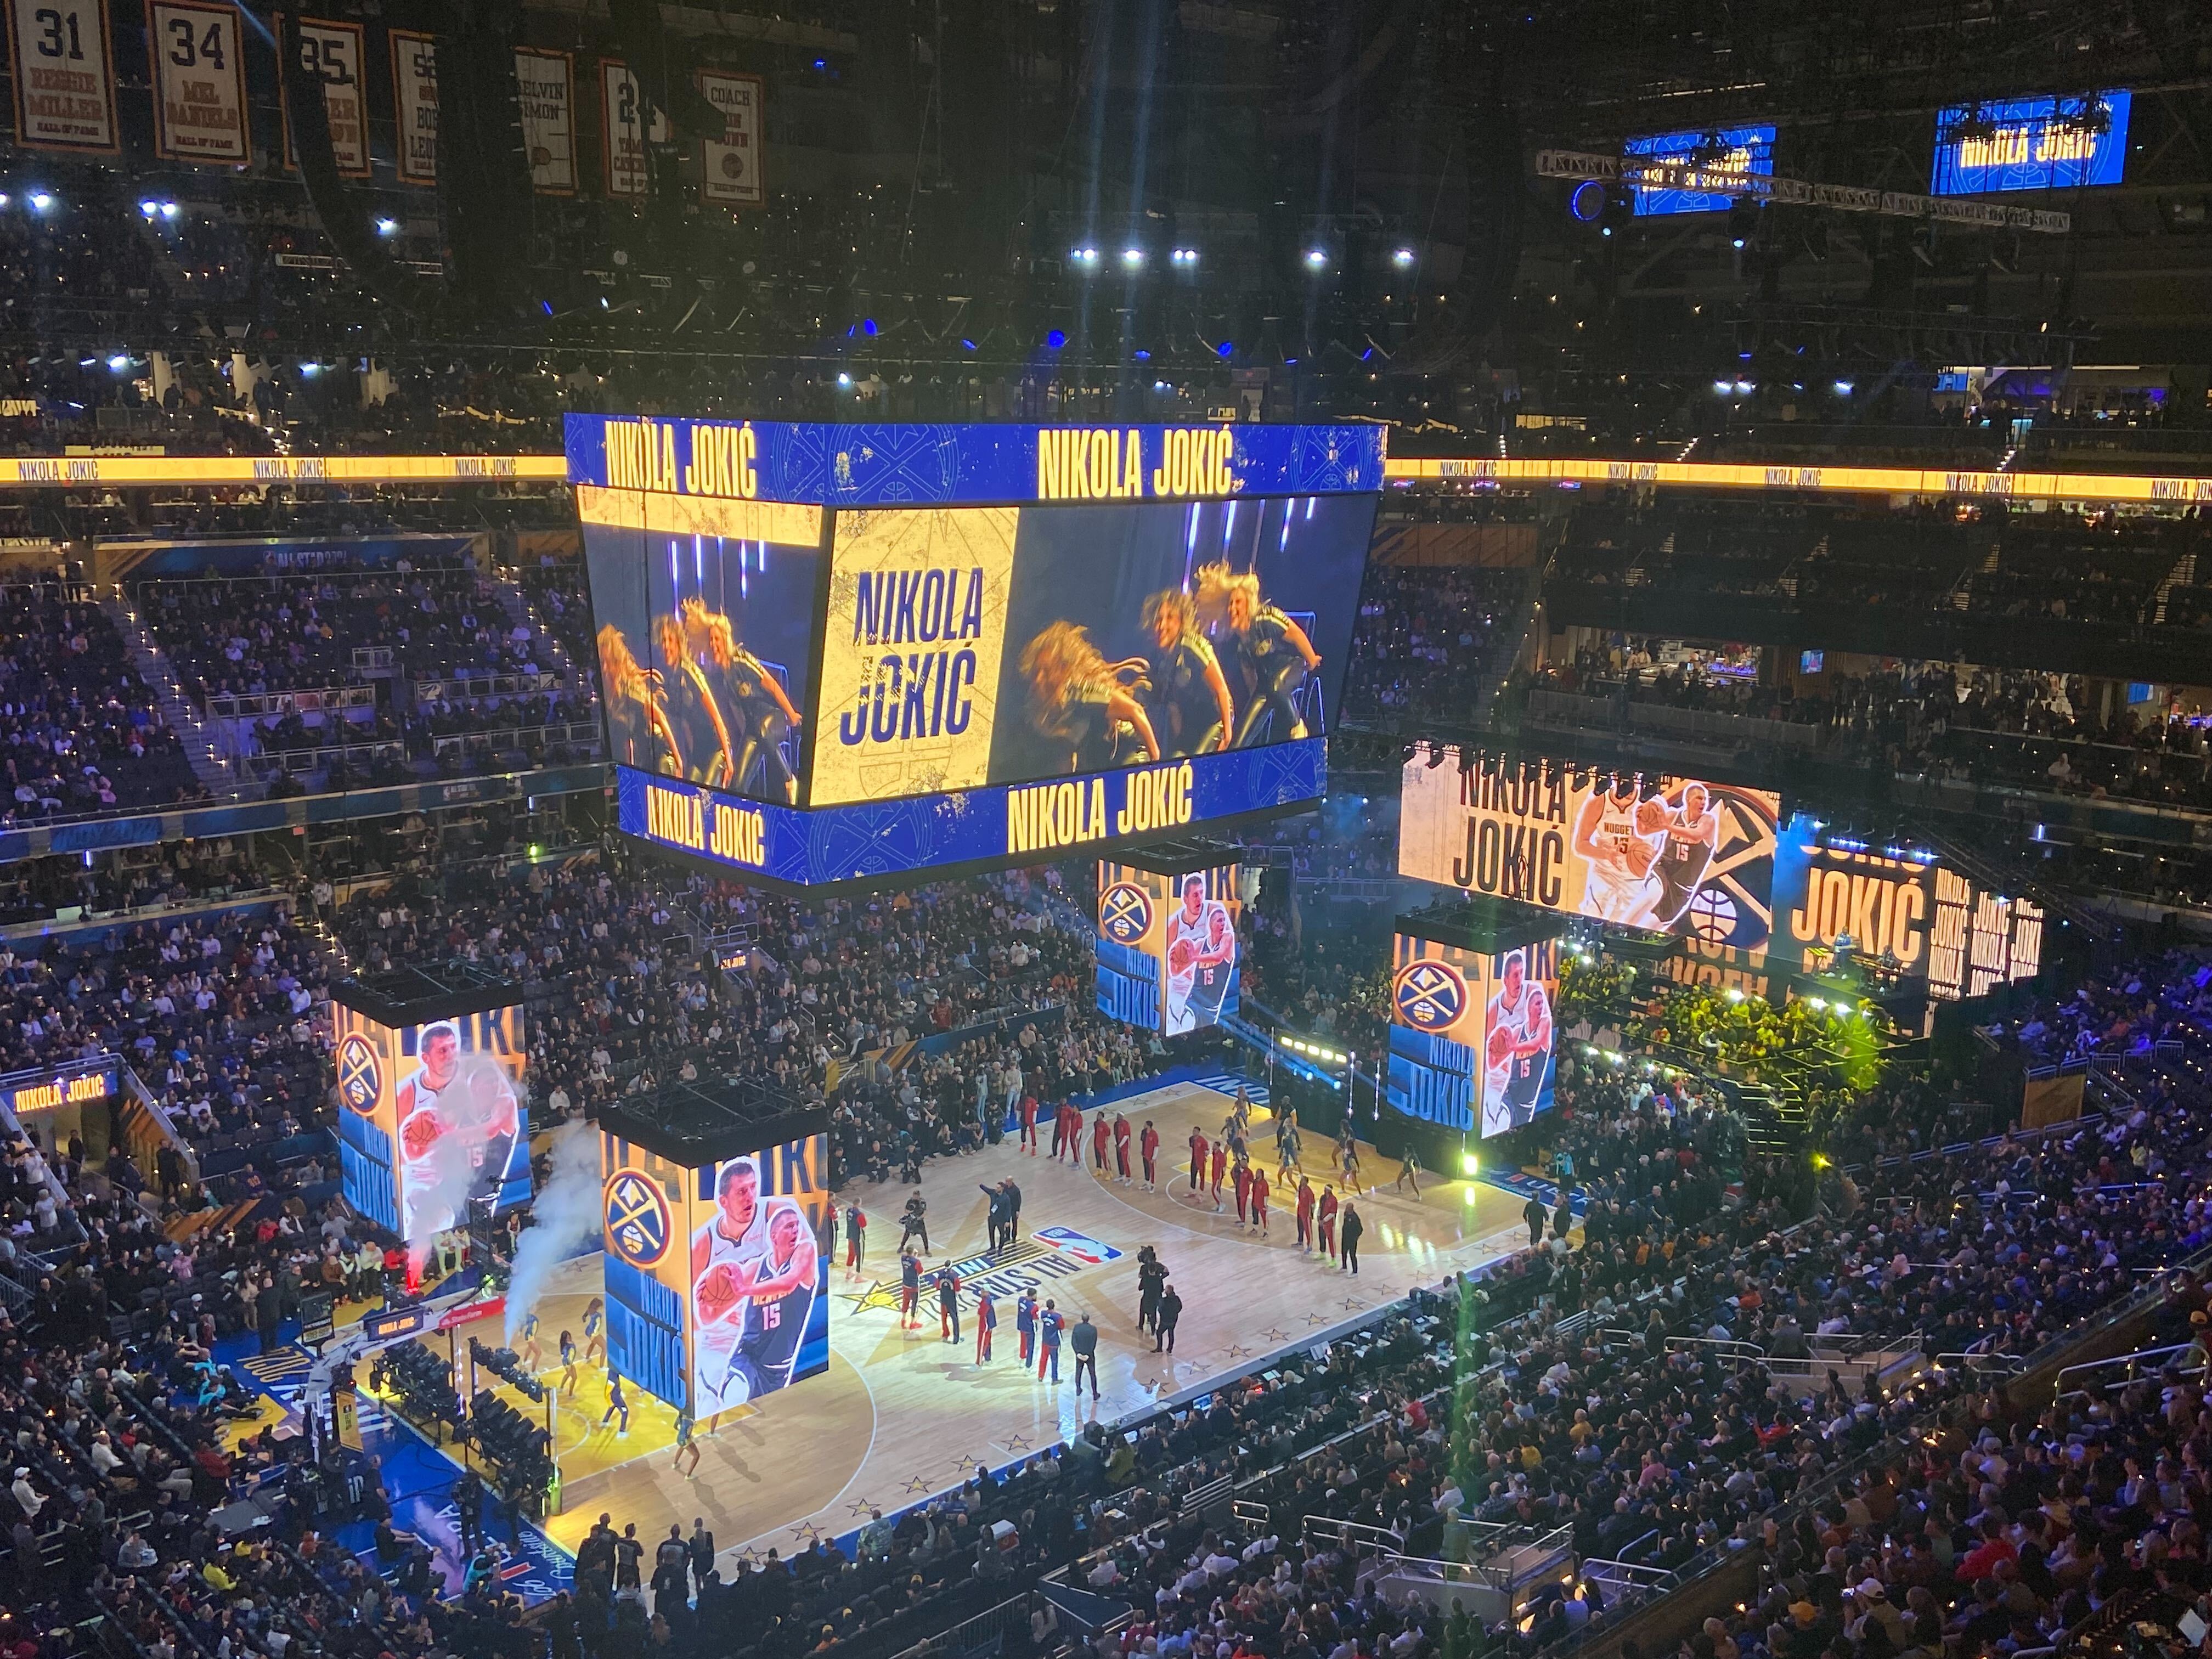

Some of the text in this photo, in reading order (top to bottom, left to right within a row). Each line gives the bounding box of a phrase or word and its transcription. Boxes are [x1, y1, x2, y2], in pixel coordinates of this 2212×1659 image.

[35, 8, 83, 60] 31
[169, 19, 224, 70] 34
[30, 67, 97, 95] REGGIE
[182, 80, 219, 104] MEL
[519, 81, 563, 99] ELVIN
[27, 94, 103, 121] MILLER
[521, 101, 559, 120] IMON
[711, 87, 750, 106] COACH
[18, 461, 59, 481] NIKOLA
[253, 459, 289, 478] NIKOLA
[455, 459, 487, 476] NIKOLA
[605, 419, 757, 498] NIKOLA JOKIĆ
[1039, 423, 1233, 499] NIKOLA JOKIĆ
[1440, 461, 1468, 476] NIKOLA
[1764, 468, 1792, 485] NIKOLA
[1946, 473, 1978, 492] NIKOLA
[2151, 481, 2188, 500] NIKOLA
[853, 567, 984, 646] NIKOLA
[839, 641, 978, 746] JOKIĆ
[1460, 760, 1566, 823] NIKOLA
[1008, 759, 1194, 854] NIKOLA JOKIĆ
[647, 785, 765, 866] NIKOLA JOKIĆ
[1453, 815, 1564, 906] JOKIĆ
[1675, 843, 1689, 861] 15
[1935, 867, 1971, 905] NIKOLA
[1791, 867, 1925, 962] JOKIĆ
[1931, 904, 1968, 951] JOKIĆ
[1971, 930, 2007, 971] NIKOLA
[1203, 969, 1214, 986] 15
[1928, 945, 1963, 985] NIKOLA
[1429, 1035, 1476, 1076] NIKOLA
[1520, 1058, 1531, 1079] 15
[14, 1084, 62, 1113] NIKOLA
[466, 1147, 483, 1168] 15
[1021, 1254, 1082, 1279] ALL
[640, 1271, 684, 1333] NIKOLA
[761, 1304, 781, 1330] 15
